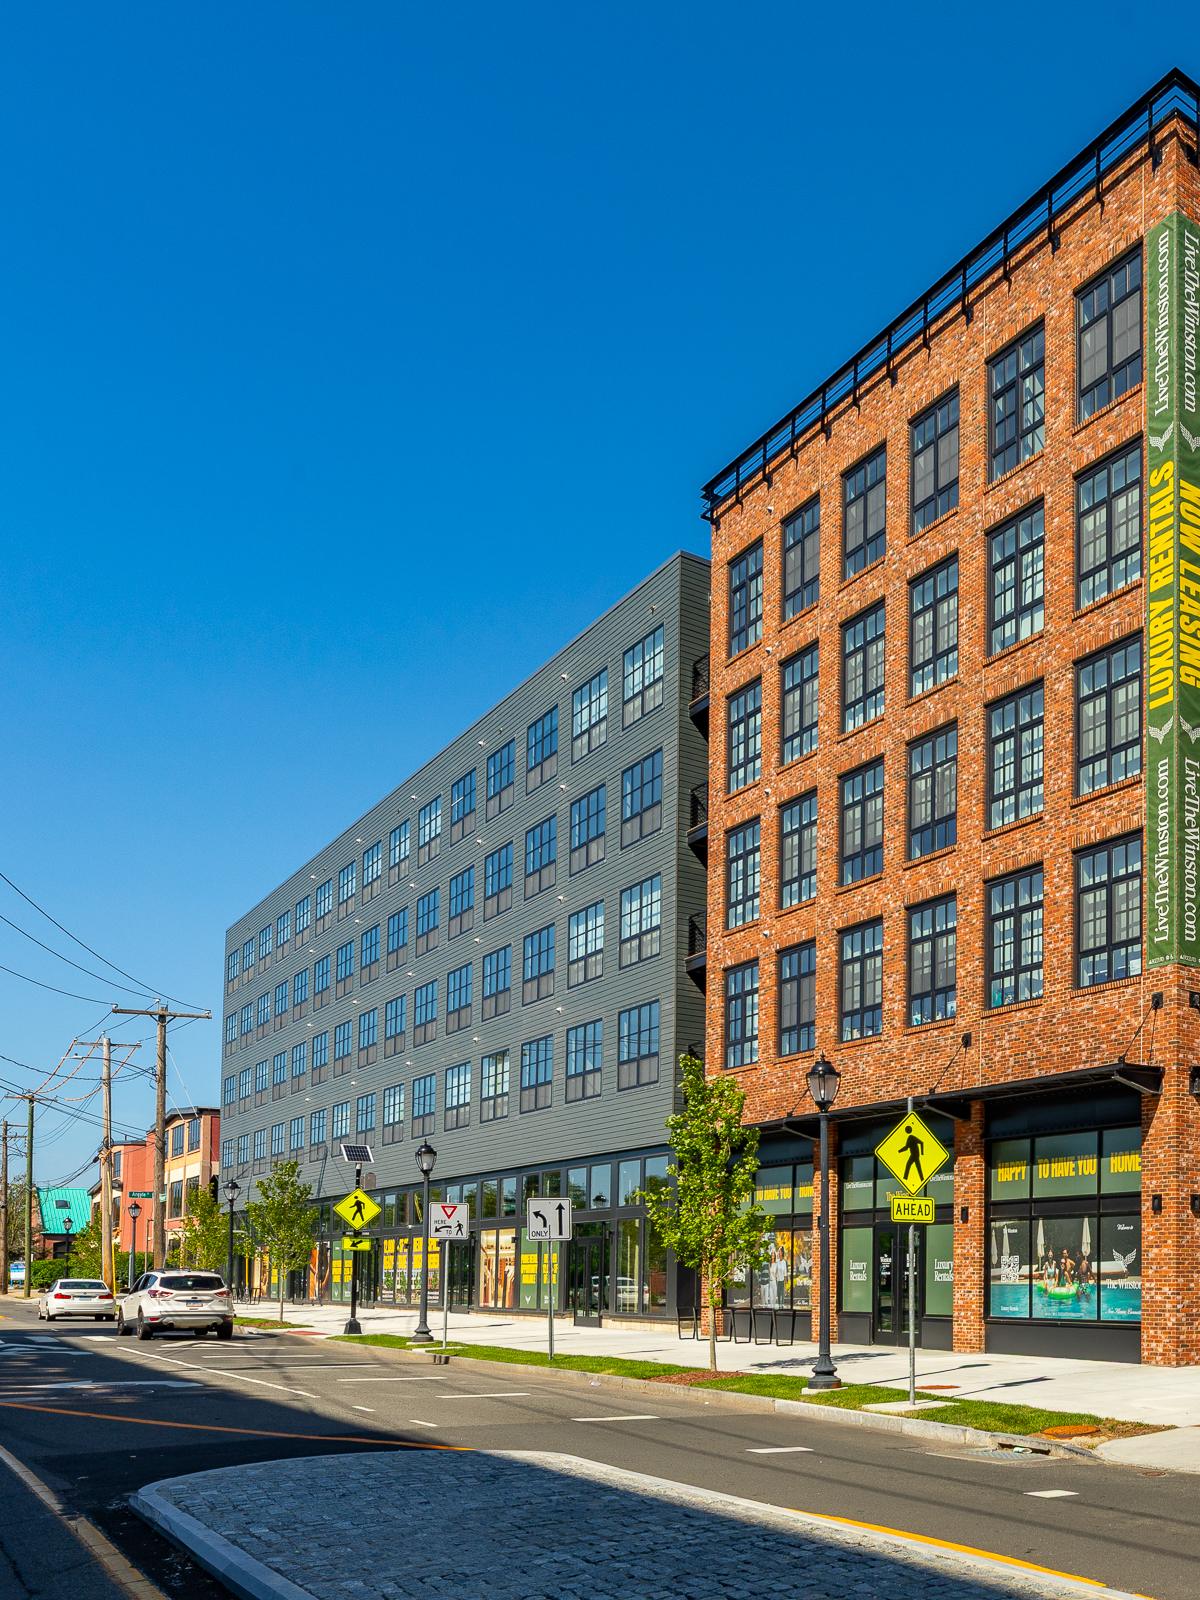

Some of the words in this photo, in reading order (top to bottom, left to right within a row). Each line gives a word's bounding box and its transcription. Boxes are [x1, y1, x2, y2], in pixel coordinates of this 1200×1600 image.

[1154, 230, 1169, 416] LiveTheWinston.com
[1184, 230, 1200, 413] LiveTheWinston.com
[1150, 461, 1174, 593] RENTALS
[1150, 597, 1174, 710] LUXURY
[1154, 757, 1169, 943] LiveTheWinston.com
[1184, 757, 1200, 941] LiveTheWinston.com
[997, 1161, 1027, 1182] HAPPY
[1038, 1159, 1050, 1179] TO
[1051, 1156, 1076, 1178] HAVE
[1077, 1154, 1097, 1175] YOU
[1110, 1151, 1142, 1173] HOME
[531, 1230, 548, 1238] ONLY
[896, 1203, 931, 1216] AHEAD
[850, 1260, 867, 1270] Luxury
[850, 1270, 867, 1281] Rentals
[1106, 1278, 1117, 1289] The
